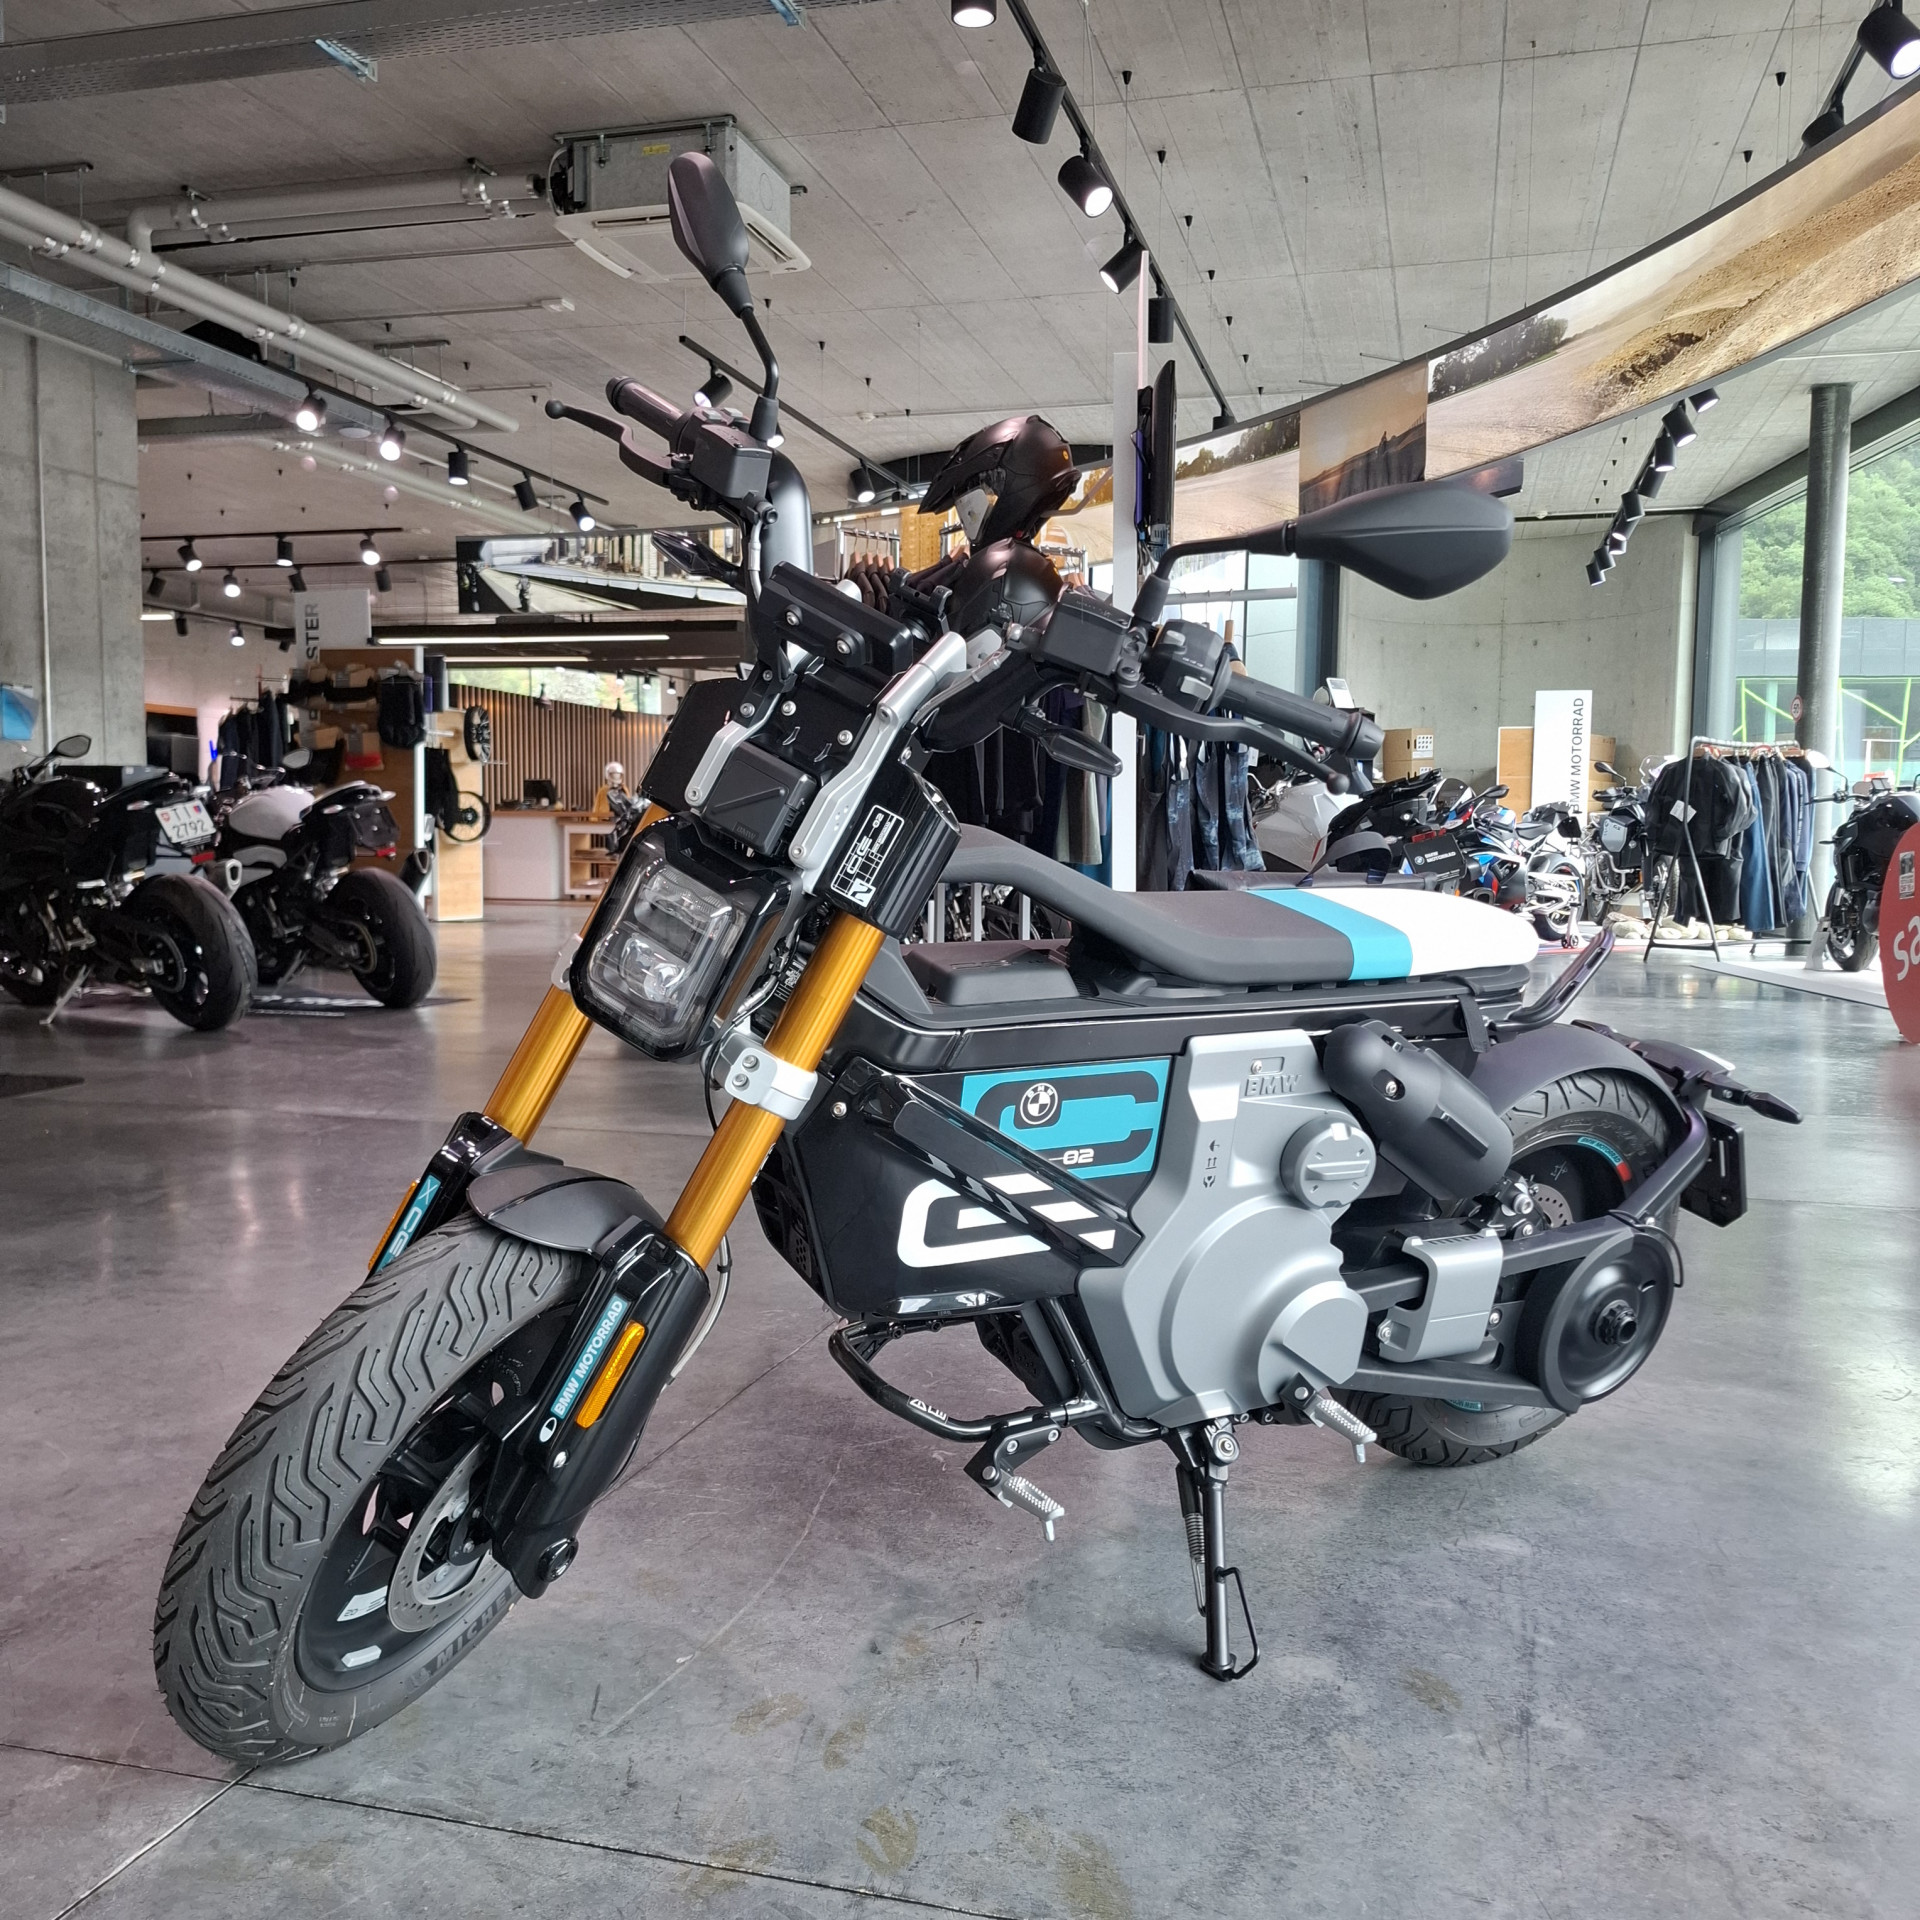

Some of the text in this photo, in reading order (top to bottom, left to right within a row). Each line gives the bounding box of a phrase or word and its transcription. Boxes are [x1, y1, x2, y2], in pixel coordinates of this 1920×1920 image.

[305, 603, 319, 660] STER
[1569, 697, 1584, 814] BMW MOTORRAD
[172, 820, 209, 839] 2792
[1244, 1074, 1302, 1097] BMW
[553, 1300, 623, 1416] BMW MOTORRAD
[436, 1581, 519, 1670] MICHEL
